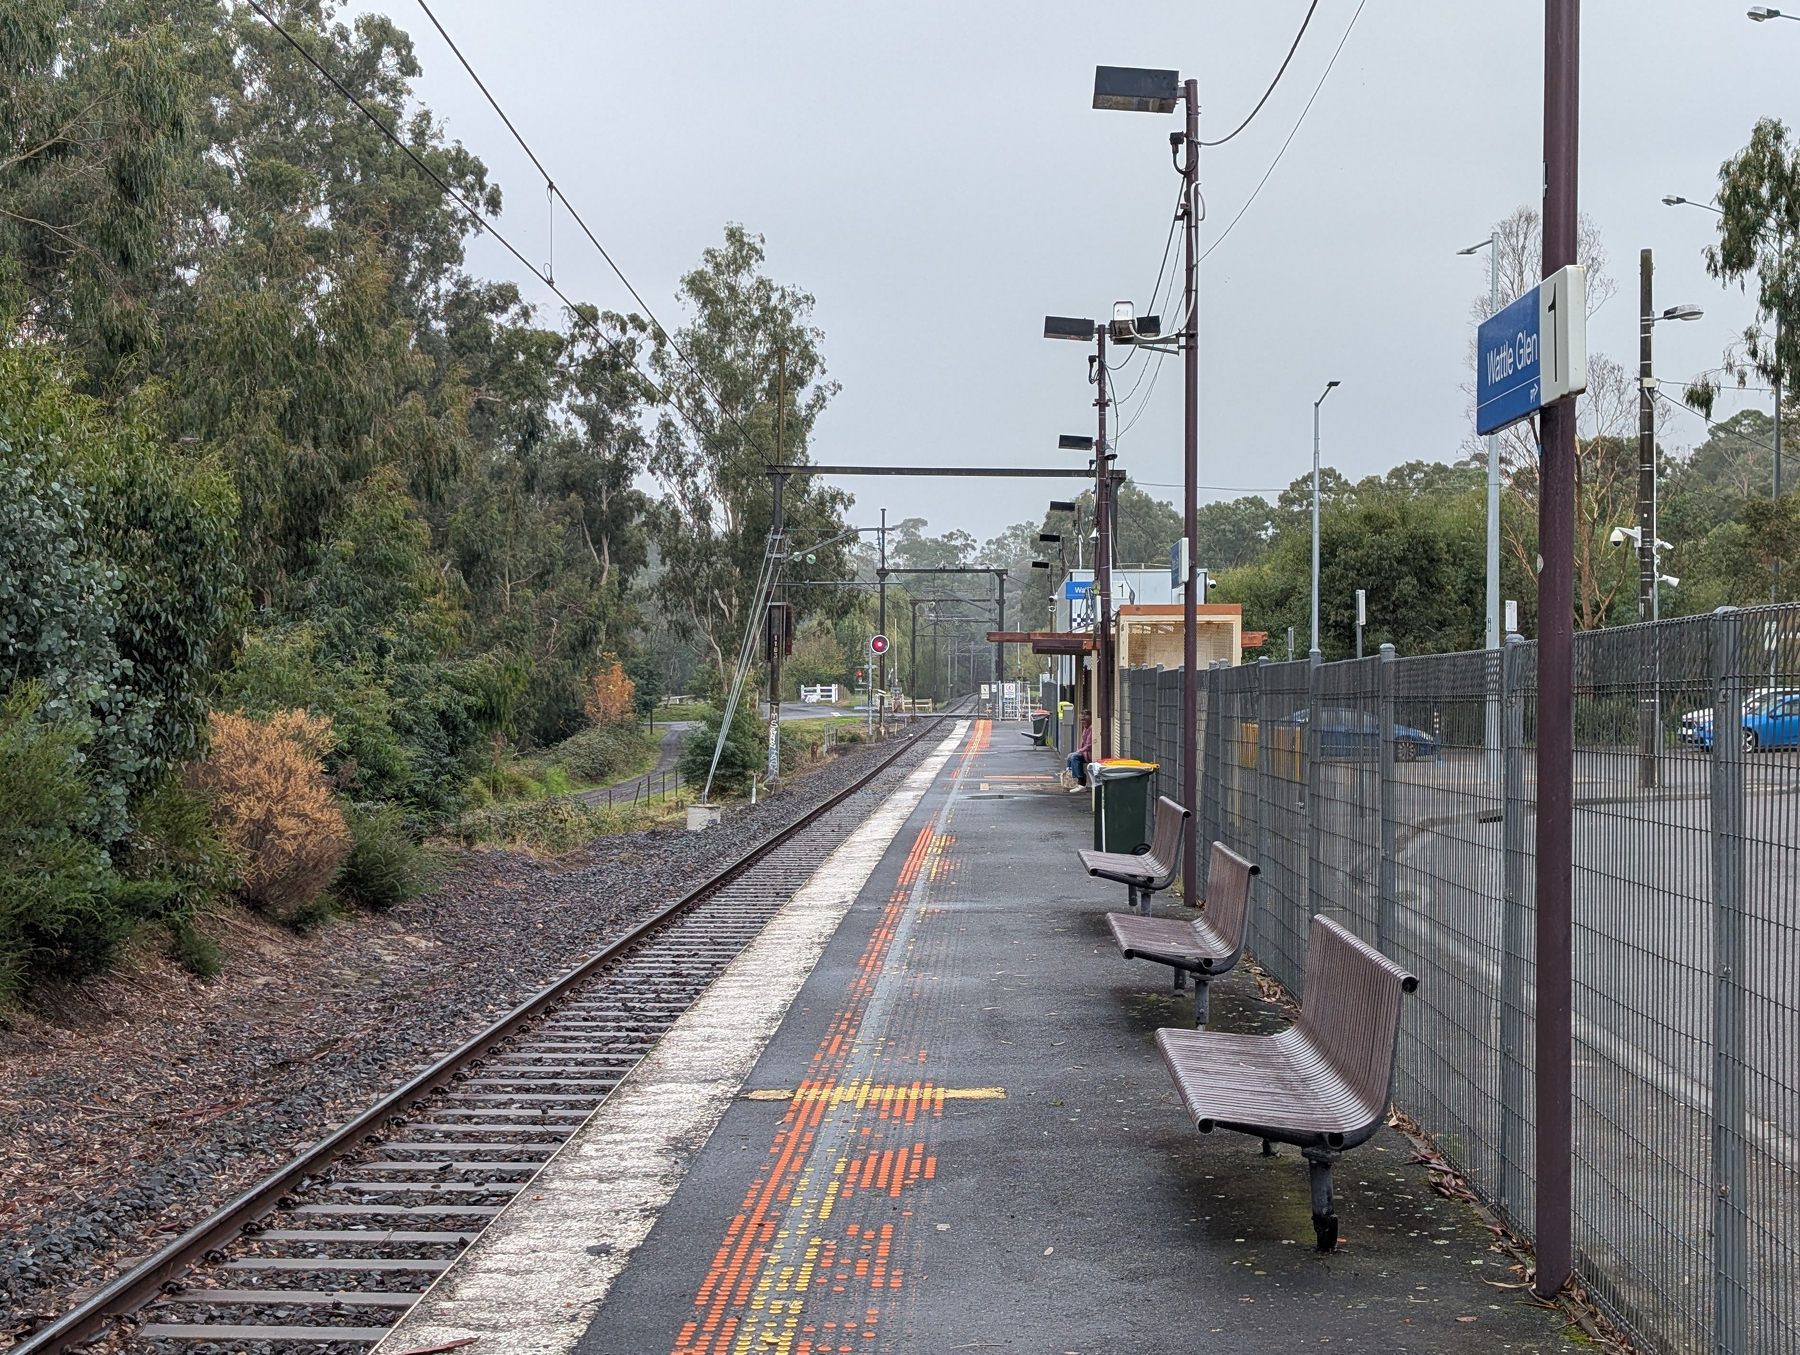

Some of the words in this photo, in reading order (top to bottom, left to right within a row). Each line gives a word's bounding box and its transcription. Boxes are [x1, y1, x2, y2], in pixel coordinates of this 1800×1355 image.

[1486, 340, 1514, 387] Wattle
[1515, 330, 1538, 371] Glen
[1547, 282, 1558, 383] 1
[1117, 583, 1124, 598] 1
